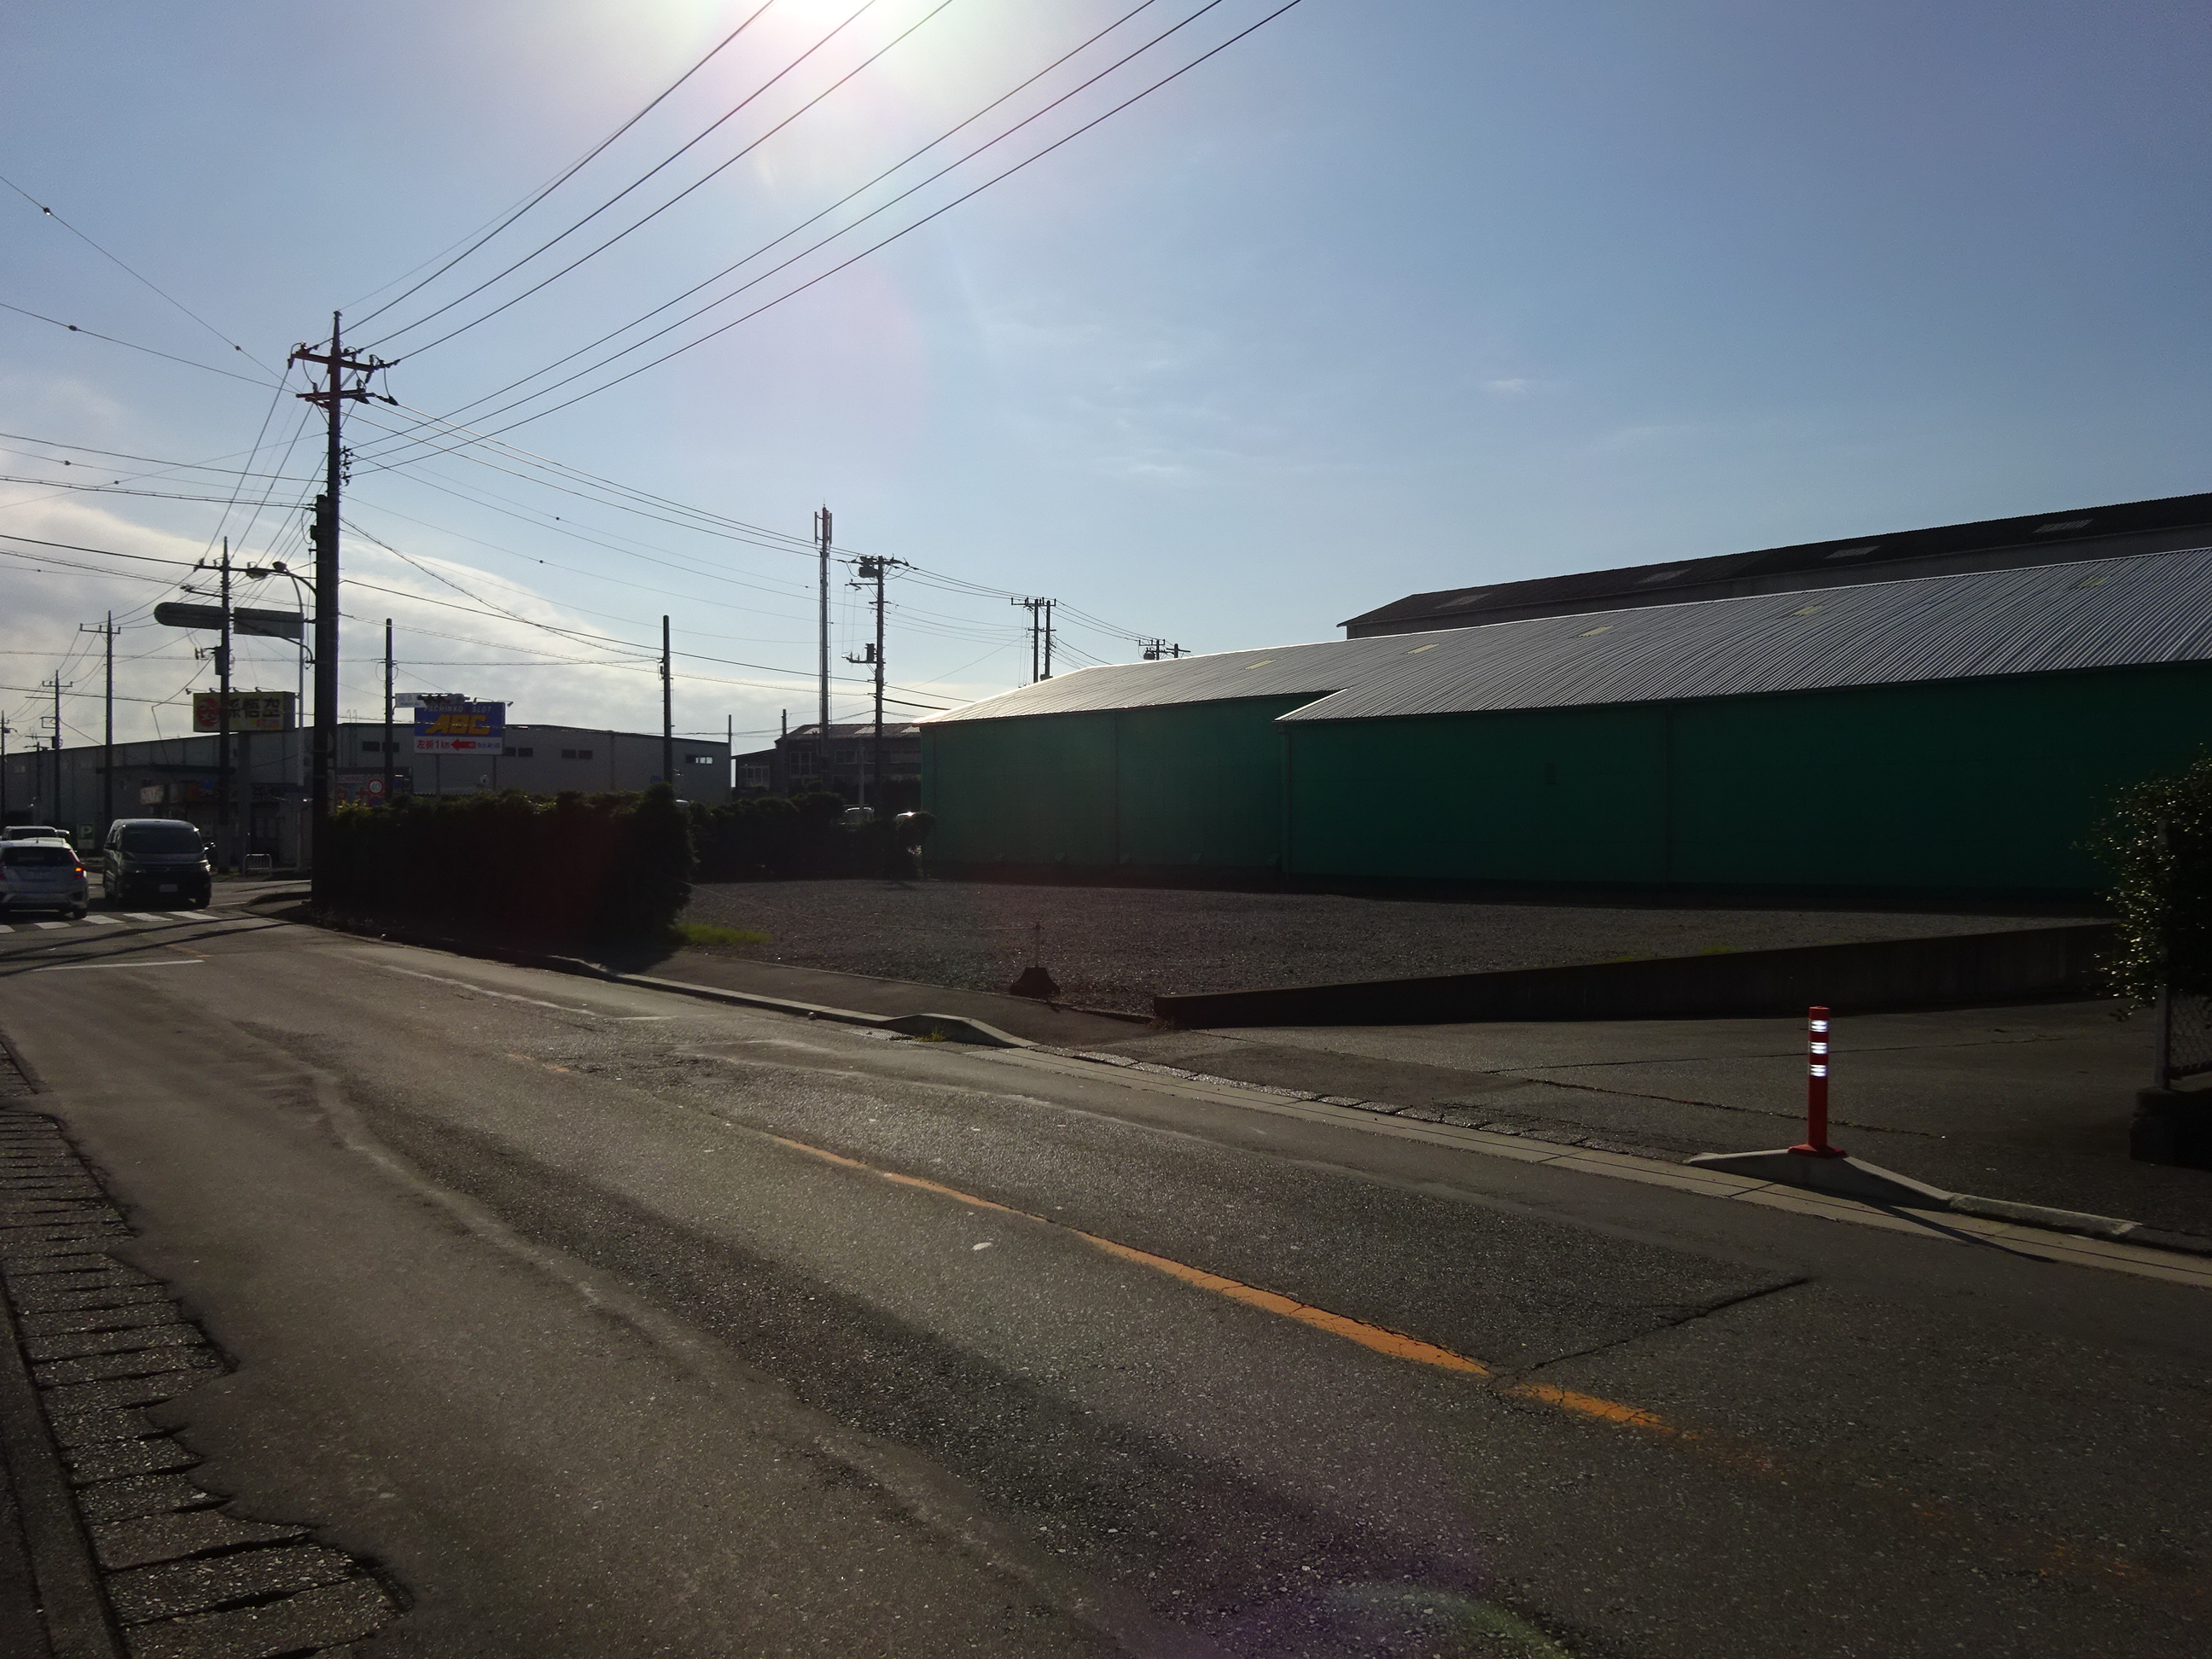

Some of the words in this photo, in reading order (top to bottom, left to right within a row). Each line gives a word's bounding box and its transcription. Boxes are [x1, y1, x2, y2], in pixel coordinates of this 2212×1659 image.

[472, 705, 492, 713] SLOT
[424, 714, 491, 735] ABC
[370, 783, 381, 791] 40
[80, 825, 93, 839] P
